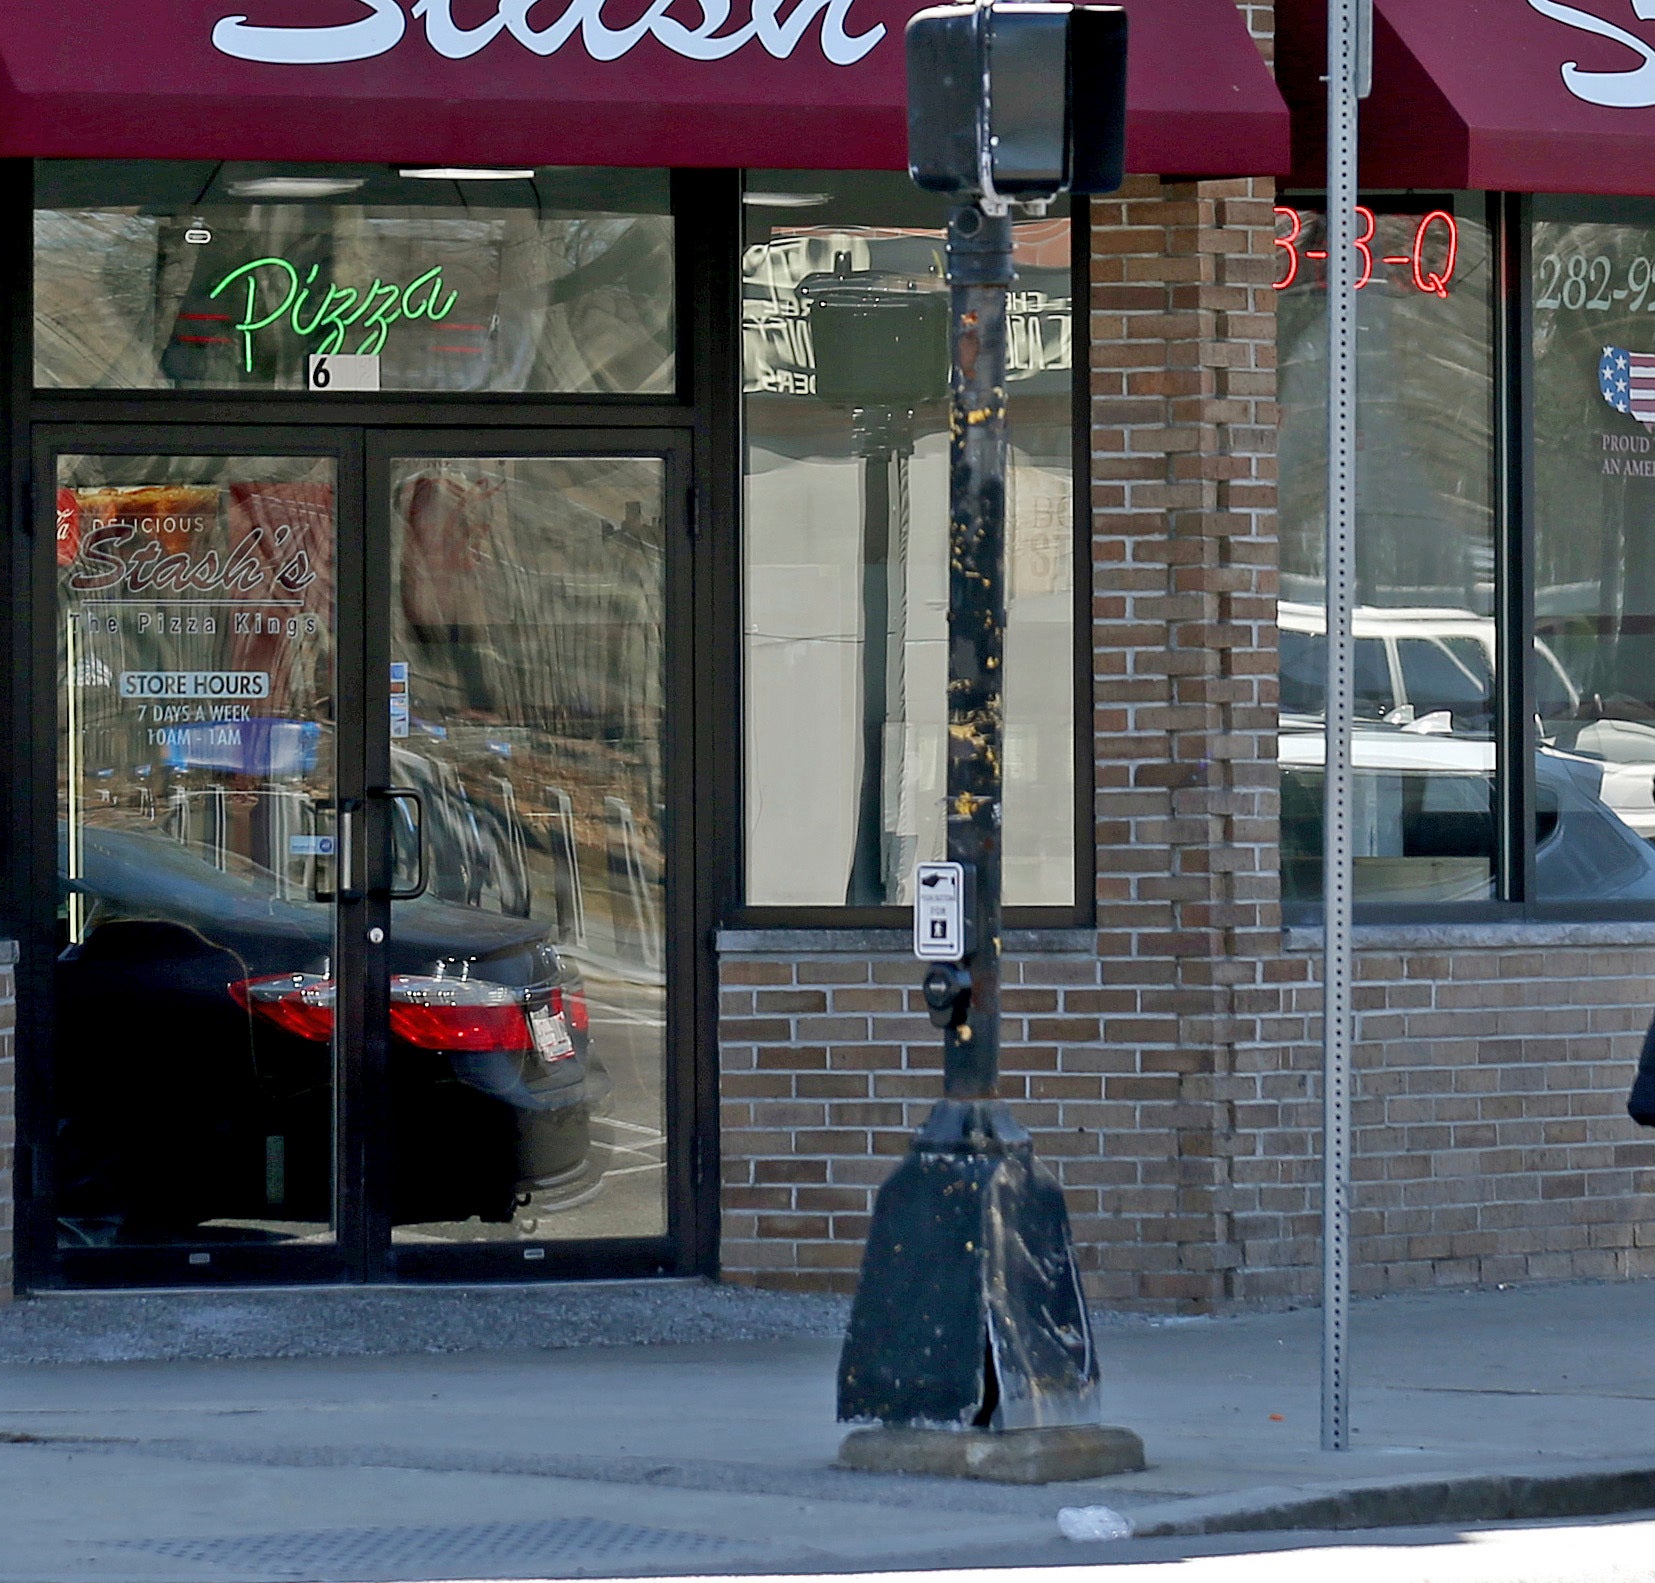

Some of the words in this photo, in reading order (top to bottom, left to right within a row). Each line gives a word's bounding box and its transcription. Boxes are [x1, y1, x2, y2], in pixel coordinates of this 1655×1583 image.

[210, 256, 459, 374] Pizza
[312, 357, 331, 388] 6
[1601, 433, 1650, 454] PROUD
[1601, 457, 1621, 475] AN
[69, 524, 318, 593] Stash's
[68, 611, 119, 636] The
[137, 611, 215, 635] Pizza
[234, 611, 318, 638] Kings
[125, 674, 187, 695] STORE
[194, 674, 264, 695] HOURS
[137, 704, 147, 723] 7
[152, 704, 191, 723] DAYS
[194, 704, 206, 723] A
[209, 704, 251, 723] WEEK
[147, 728, 192, 746] 10AM
[208, 728, 242, 746] 1AM
